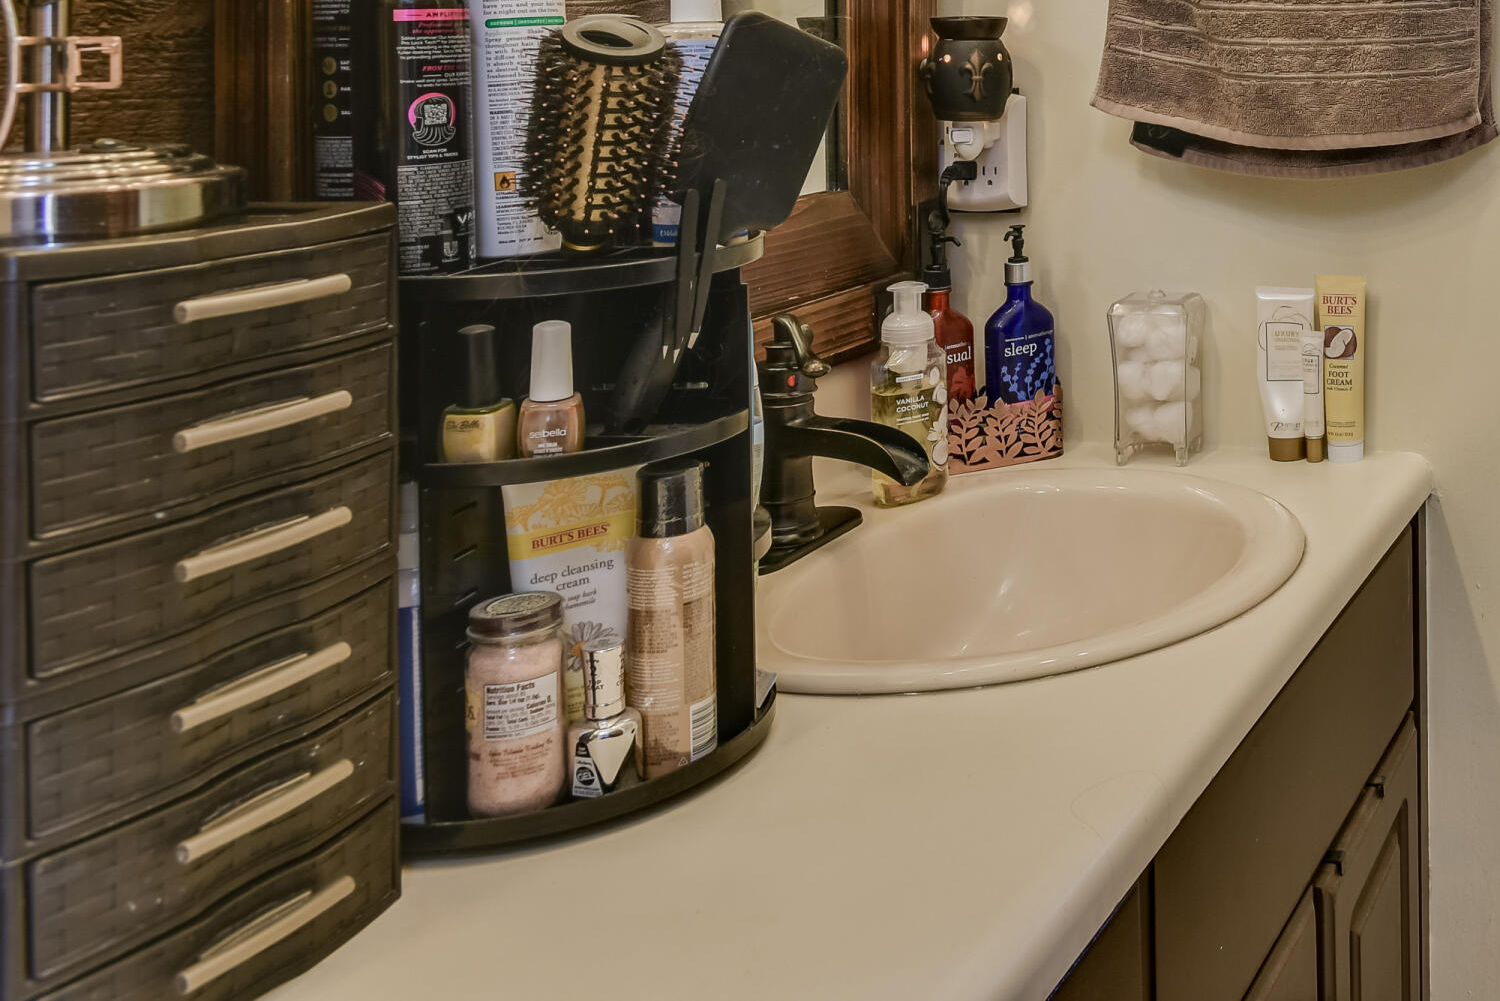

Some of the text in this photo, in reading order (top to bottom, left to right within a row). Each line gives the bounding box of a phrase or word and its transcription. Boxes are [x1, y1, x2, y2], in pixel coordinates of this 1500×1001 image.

[1322, 295, 1357, 305] BURT'S
[1327, 305, 1353, 315] BEES
[1004, 343, 1037, 357] sleep
[1328, 370, 1350, 378] FOOT
[1326, 378, 1353, 386] CREAM
[896, 395, 925, 405] VANILLA
[896, 401, 929, 413] COCONUT
[532, 524, 609, 550] BURT'S BEES
[530, 559, 614, 585] deep cleansing
[556, 577, 590, 591] cream
[486, 683, 536, 694] Nutrition Facts
